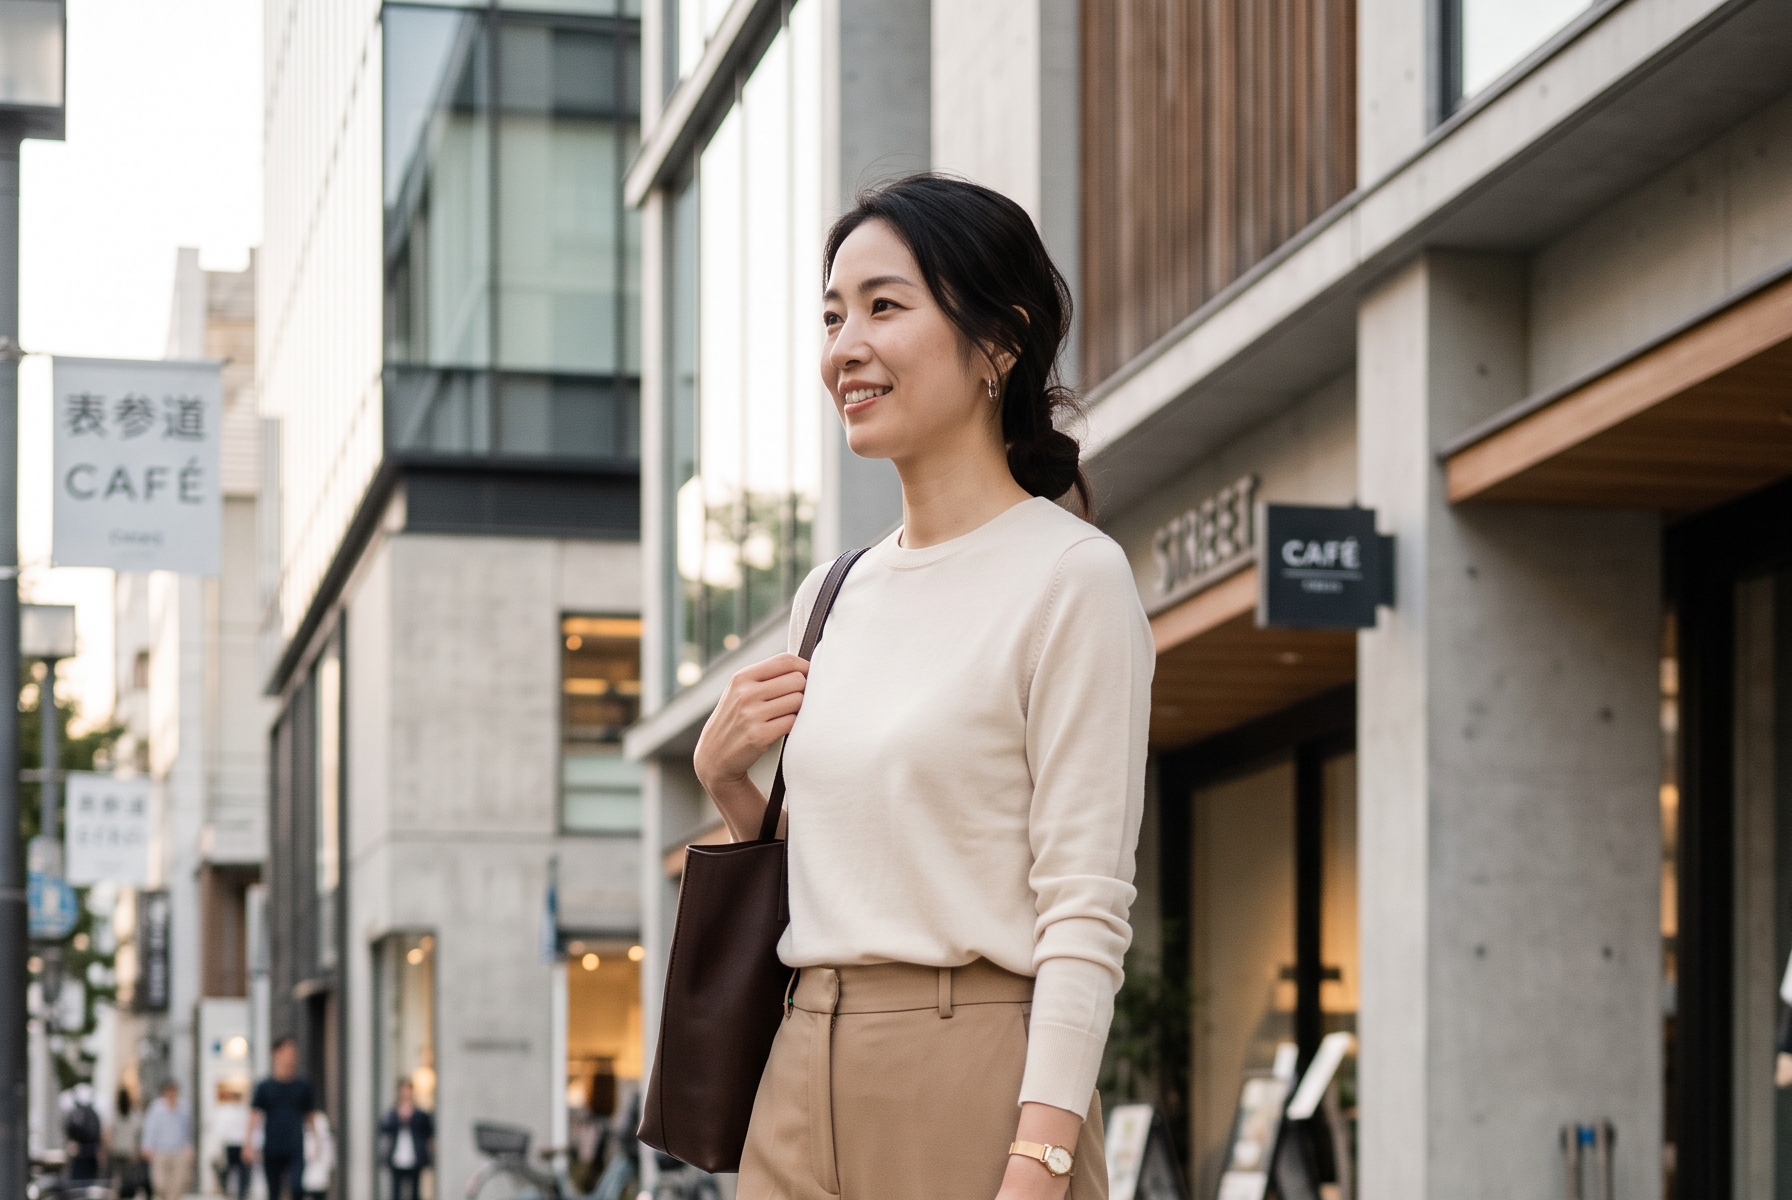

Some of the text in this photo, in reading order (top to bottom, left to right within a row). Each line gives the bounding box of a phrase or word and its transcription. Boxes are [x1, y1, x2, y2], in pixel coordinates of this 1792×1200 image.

[65, 391, 206, 440] 表参道
[65, 457, 204, 504] CAFÉ
[1152, 476, 1256, 593] STREET
[1282, 536, 1361, 570] CAFÉ
